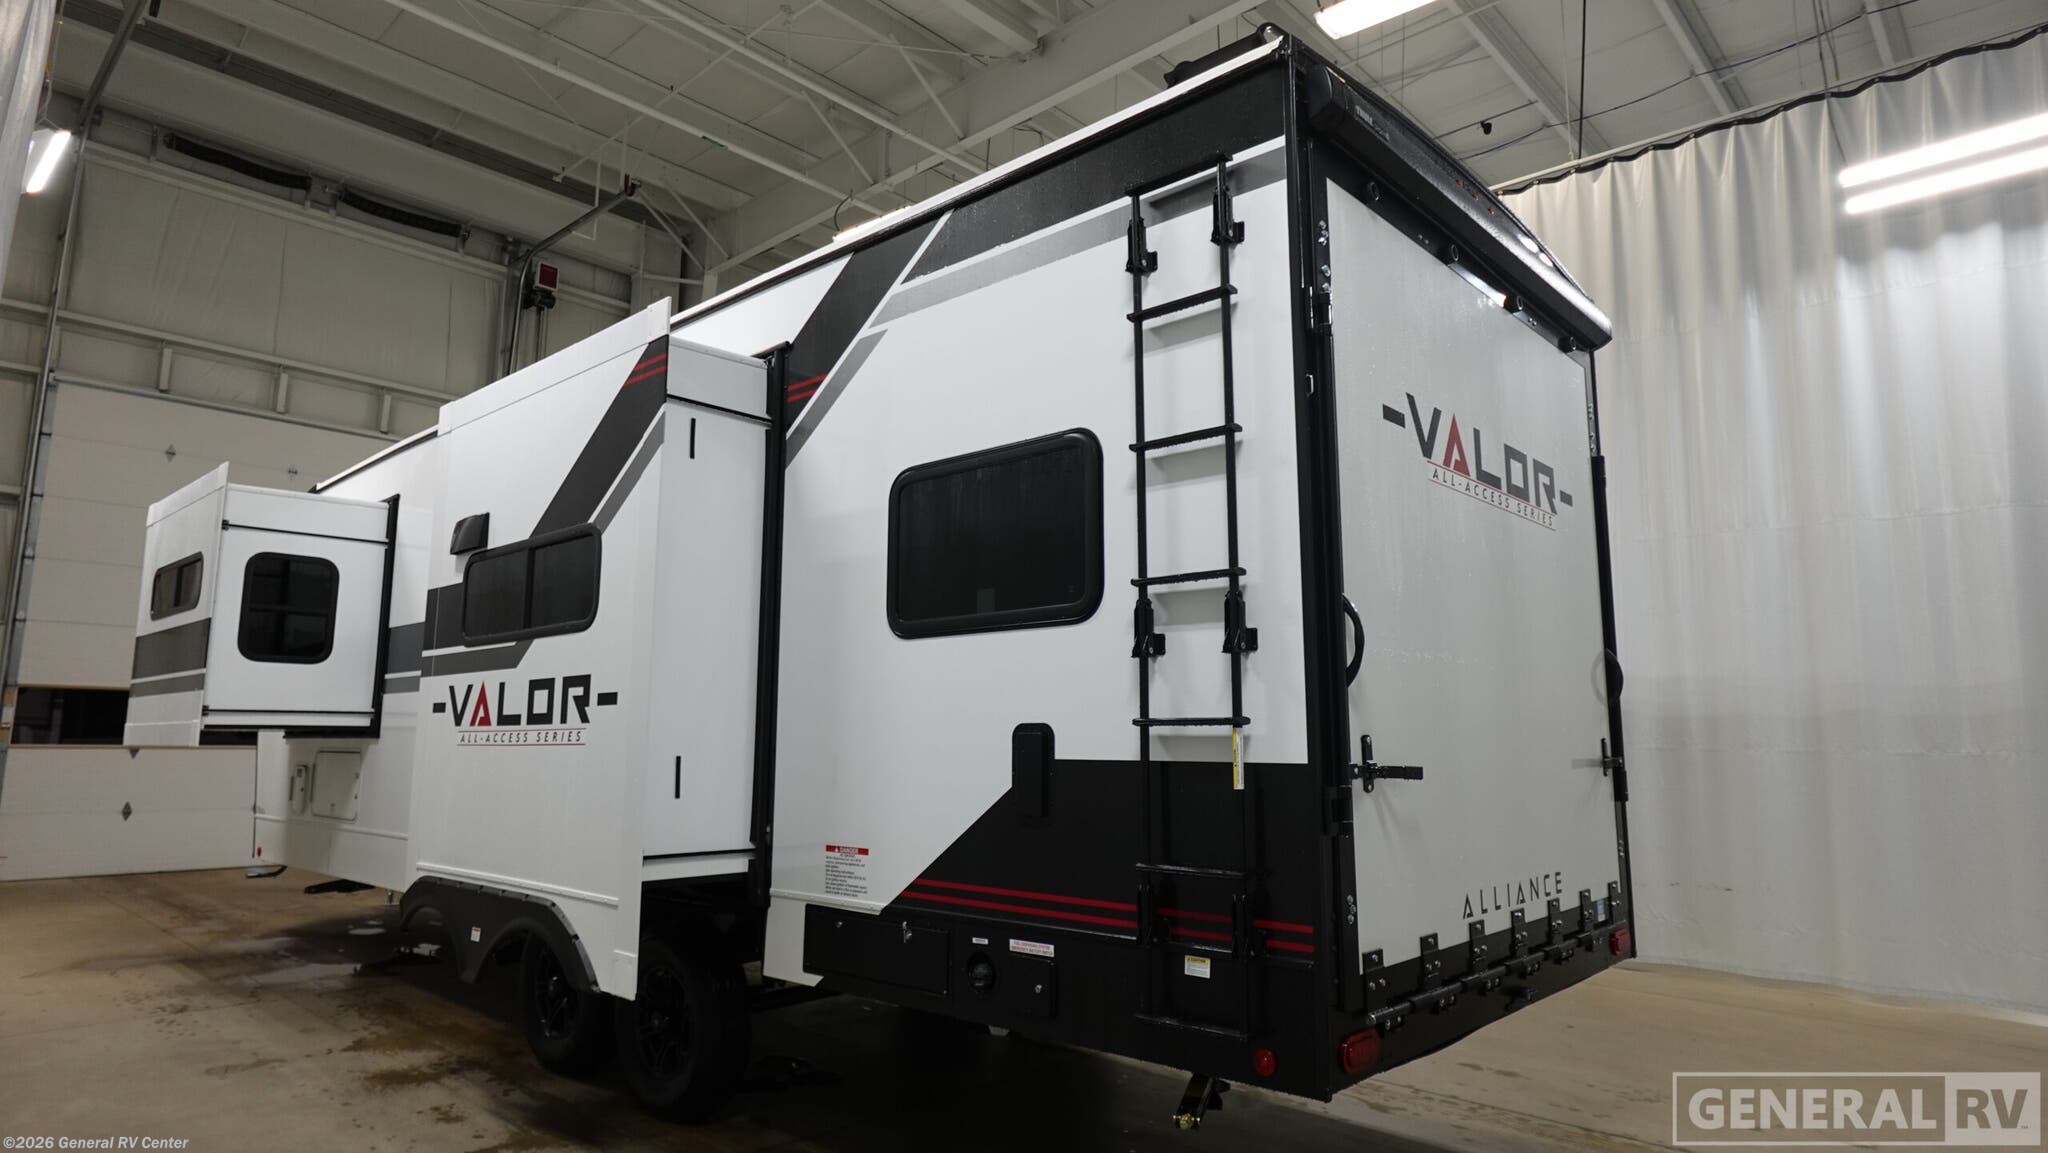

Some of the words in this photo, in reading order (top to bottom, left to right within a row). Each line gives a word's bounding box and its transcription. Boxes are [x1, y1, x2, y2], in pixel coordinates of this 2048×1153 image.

[1432, 468, 1510, 509] ALL-ACCESS
[1516, 502, 1554, 527] SERIES
[460, 732, 528, 743] ALL-ACCESS
[536, 731, 582, 742] SERIES
[1462, 871, 1562, 919] ALLIANCE
